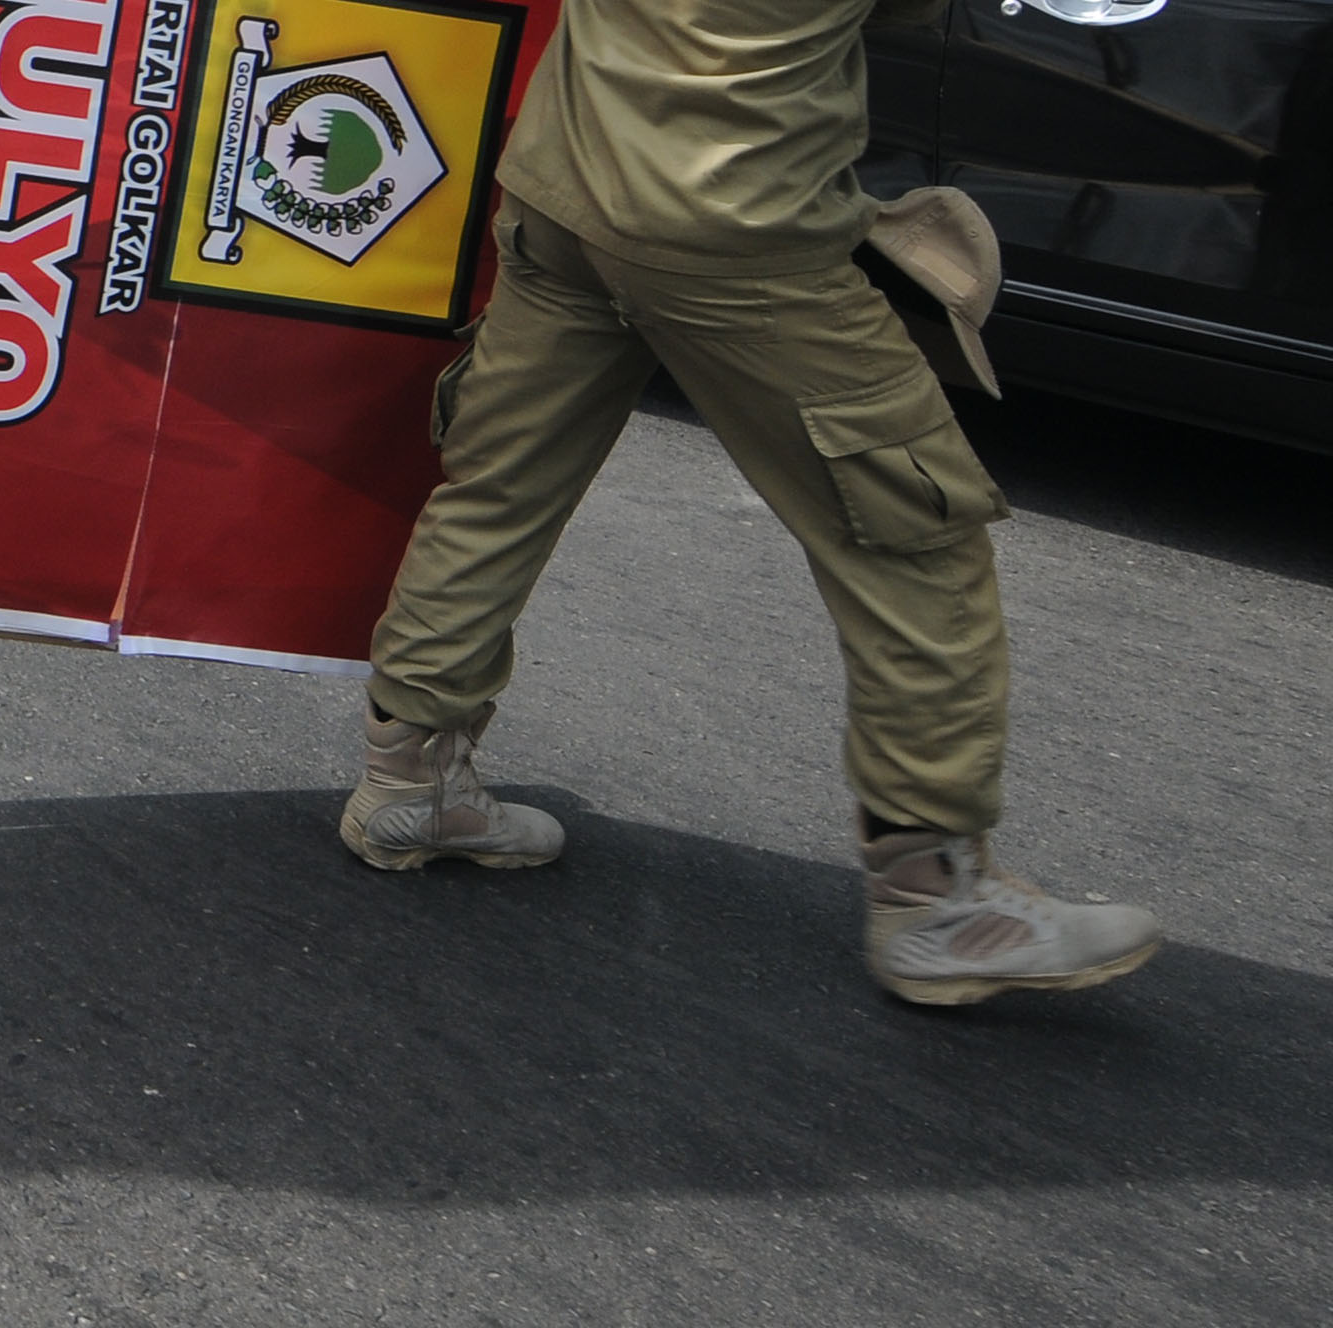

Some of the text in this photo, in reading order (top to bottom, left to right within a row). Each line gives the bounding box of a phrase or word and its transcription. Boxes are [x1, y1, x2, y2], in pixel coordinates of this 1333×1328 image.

[102, 116, 170, 310] GOLKAR
[212, 61, 251, 218] GOLONGAN KARYA
